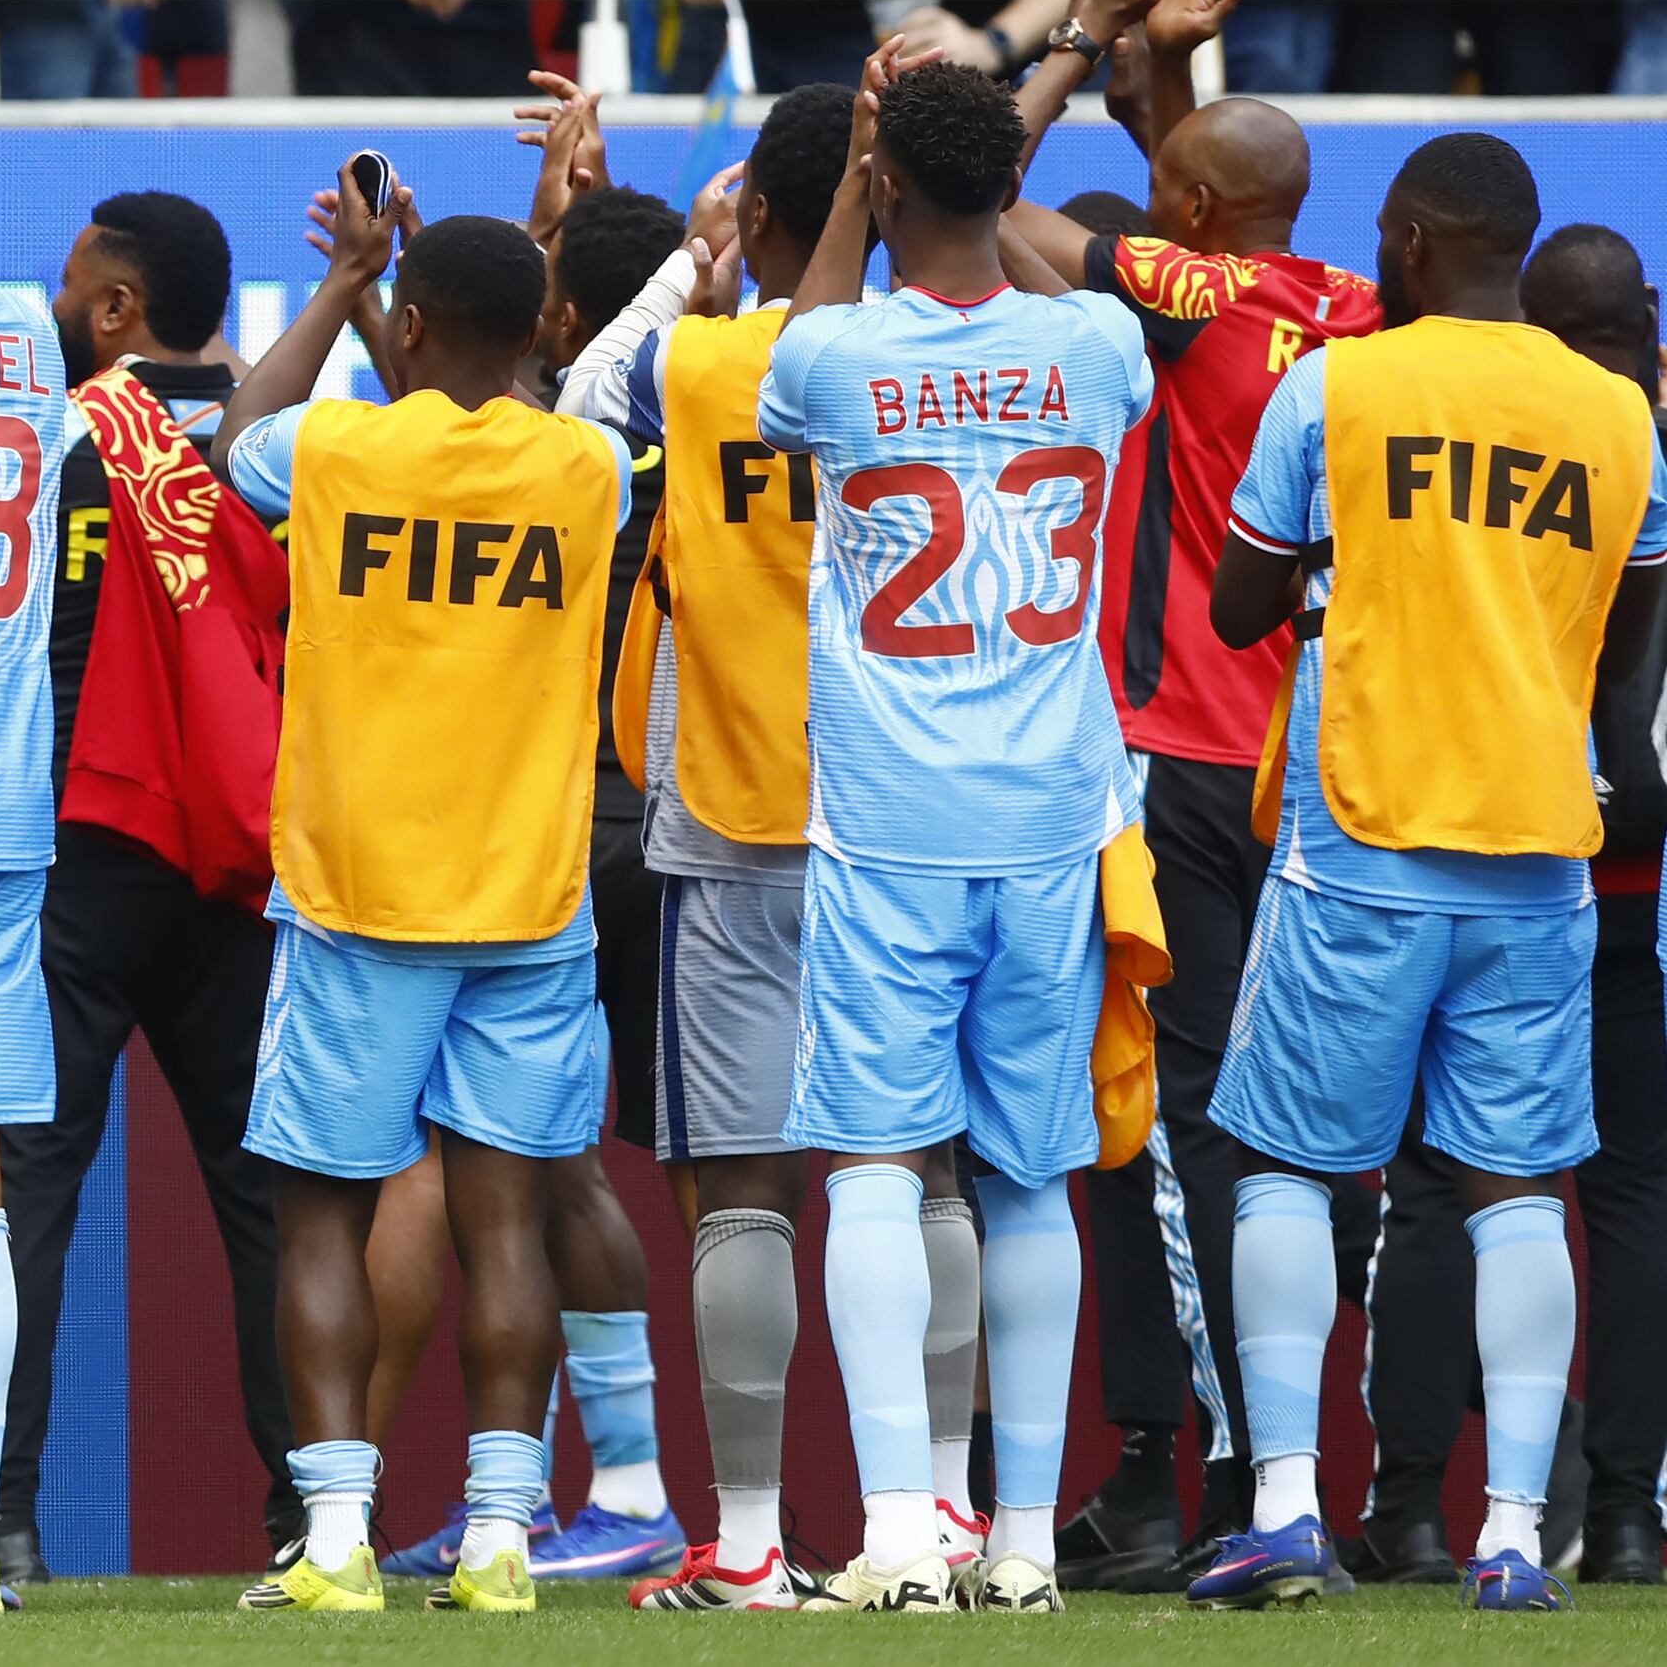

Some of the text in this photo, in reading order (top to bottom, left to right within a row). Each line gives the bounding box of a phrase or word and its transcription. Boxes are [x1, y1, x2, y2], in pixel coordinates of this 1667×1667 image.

[868, 364, 1070, 436] BANZA
[1385, 435, 1593, 553] FIFA
[338, 511, 564, 611] FIFA
[839, 445, 1108, 660] 23
